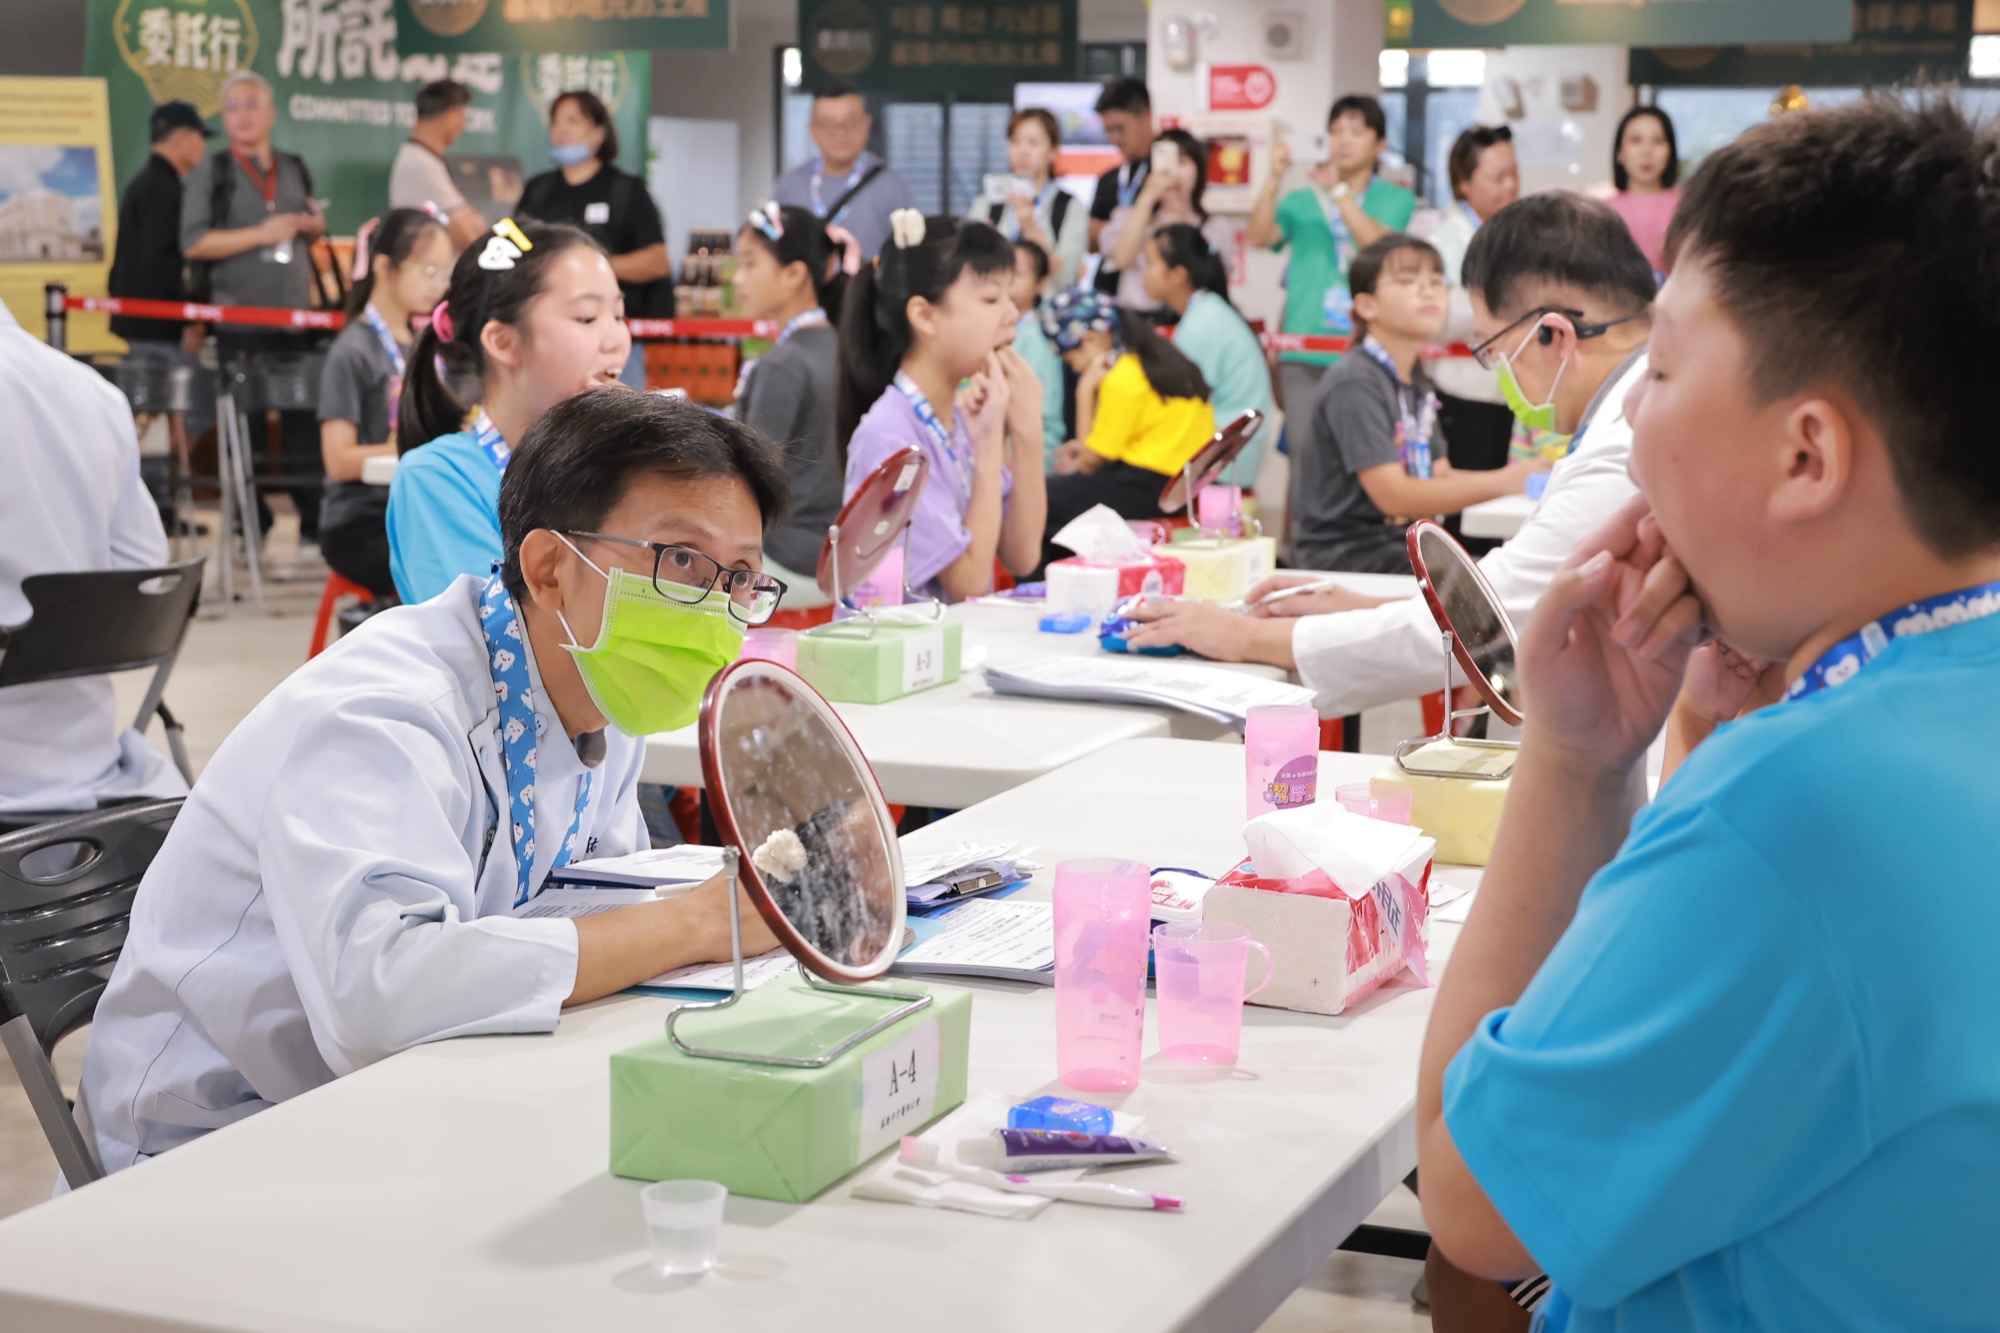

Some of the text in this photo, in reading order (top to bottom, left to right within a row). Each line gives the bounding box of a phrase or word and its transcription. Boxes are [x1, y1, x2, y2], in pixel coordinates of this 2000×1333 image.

[138, 7, 242, 72] 委託行
[888, 1048, 917, 1097] A-4
